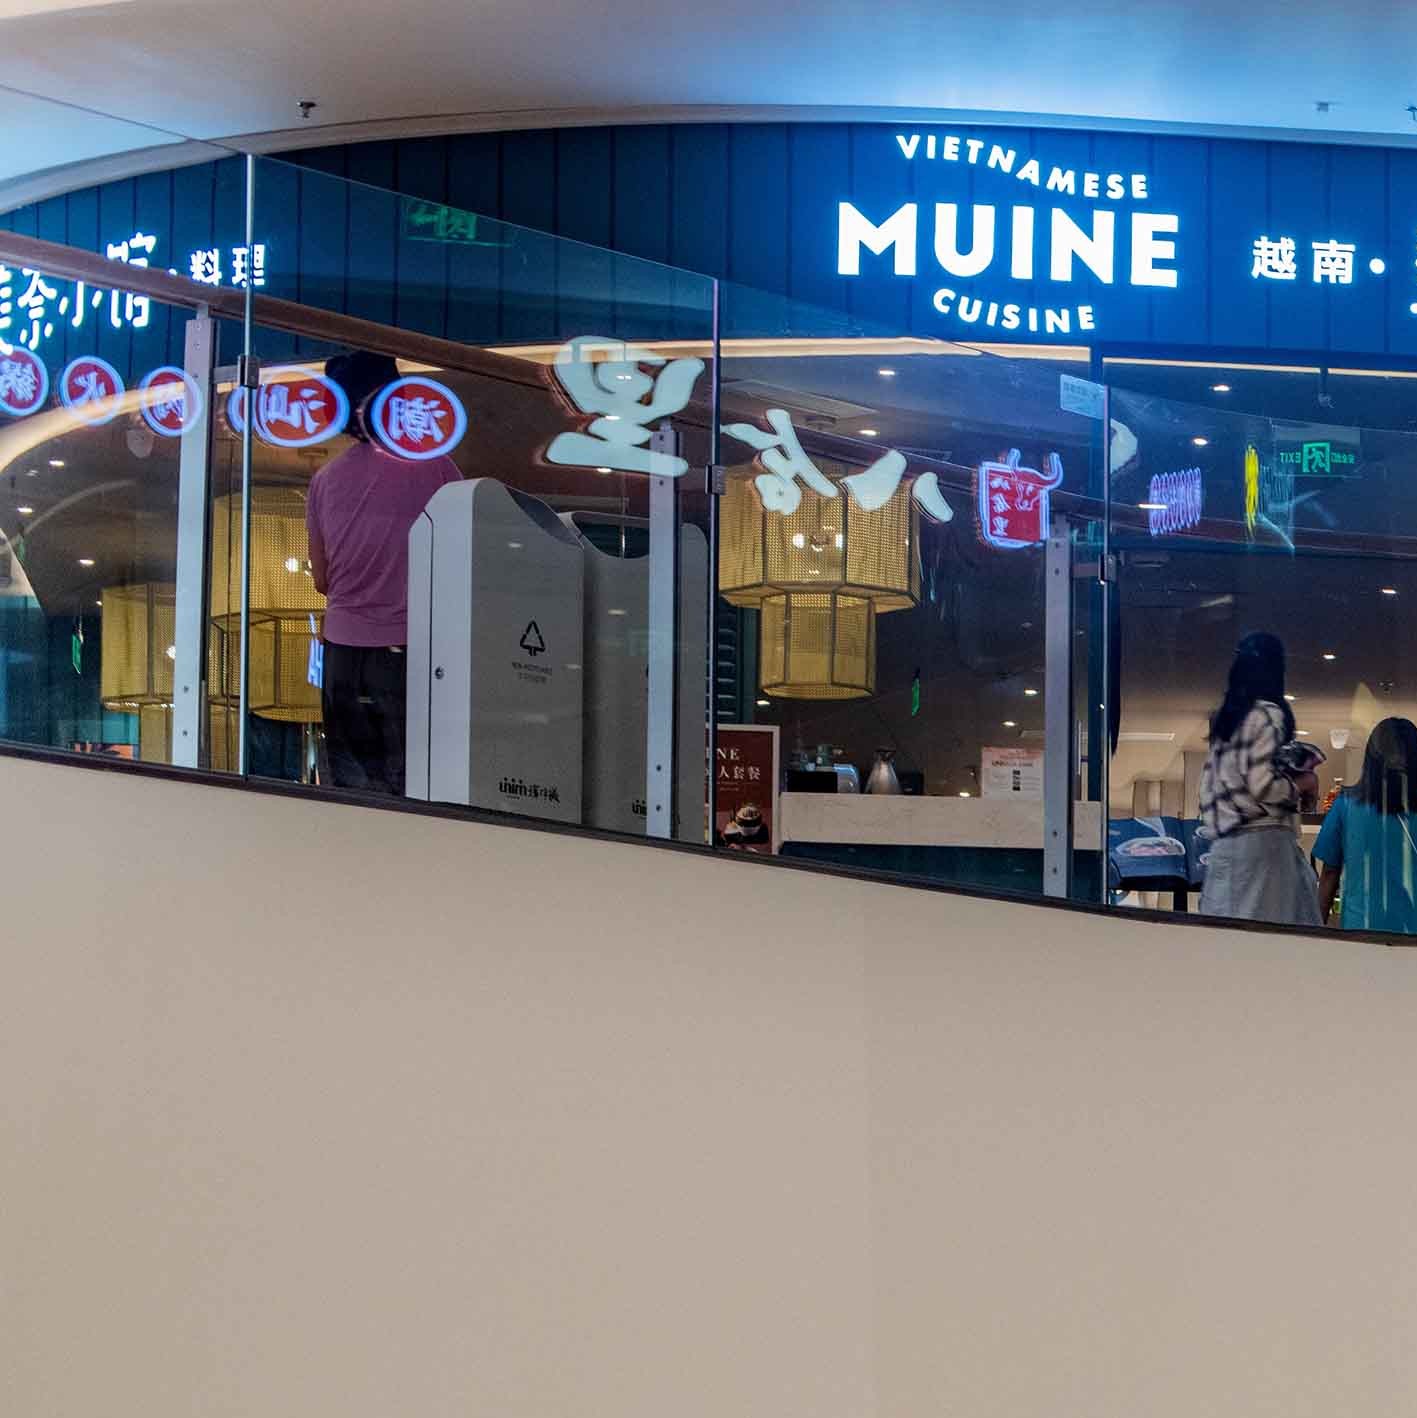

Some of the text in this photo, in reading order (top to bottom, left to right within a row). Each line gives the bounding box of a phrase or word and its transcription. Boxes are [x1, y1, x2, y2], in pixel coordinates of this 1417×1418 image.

[896, 135, 1148, 200] VIETNAMESE
[838, 201, 1180, 289] MUINE
[933, 288, 1096, 334] CUISINE
